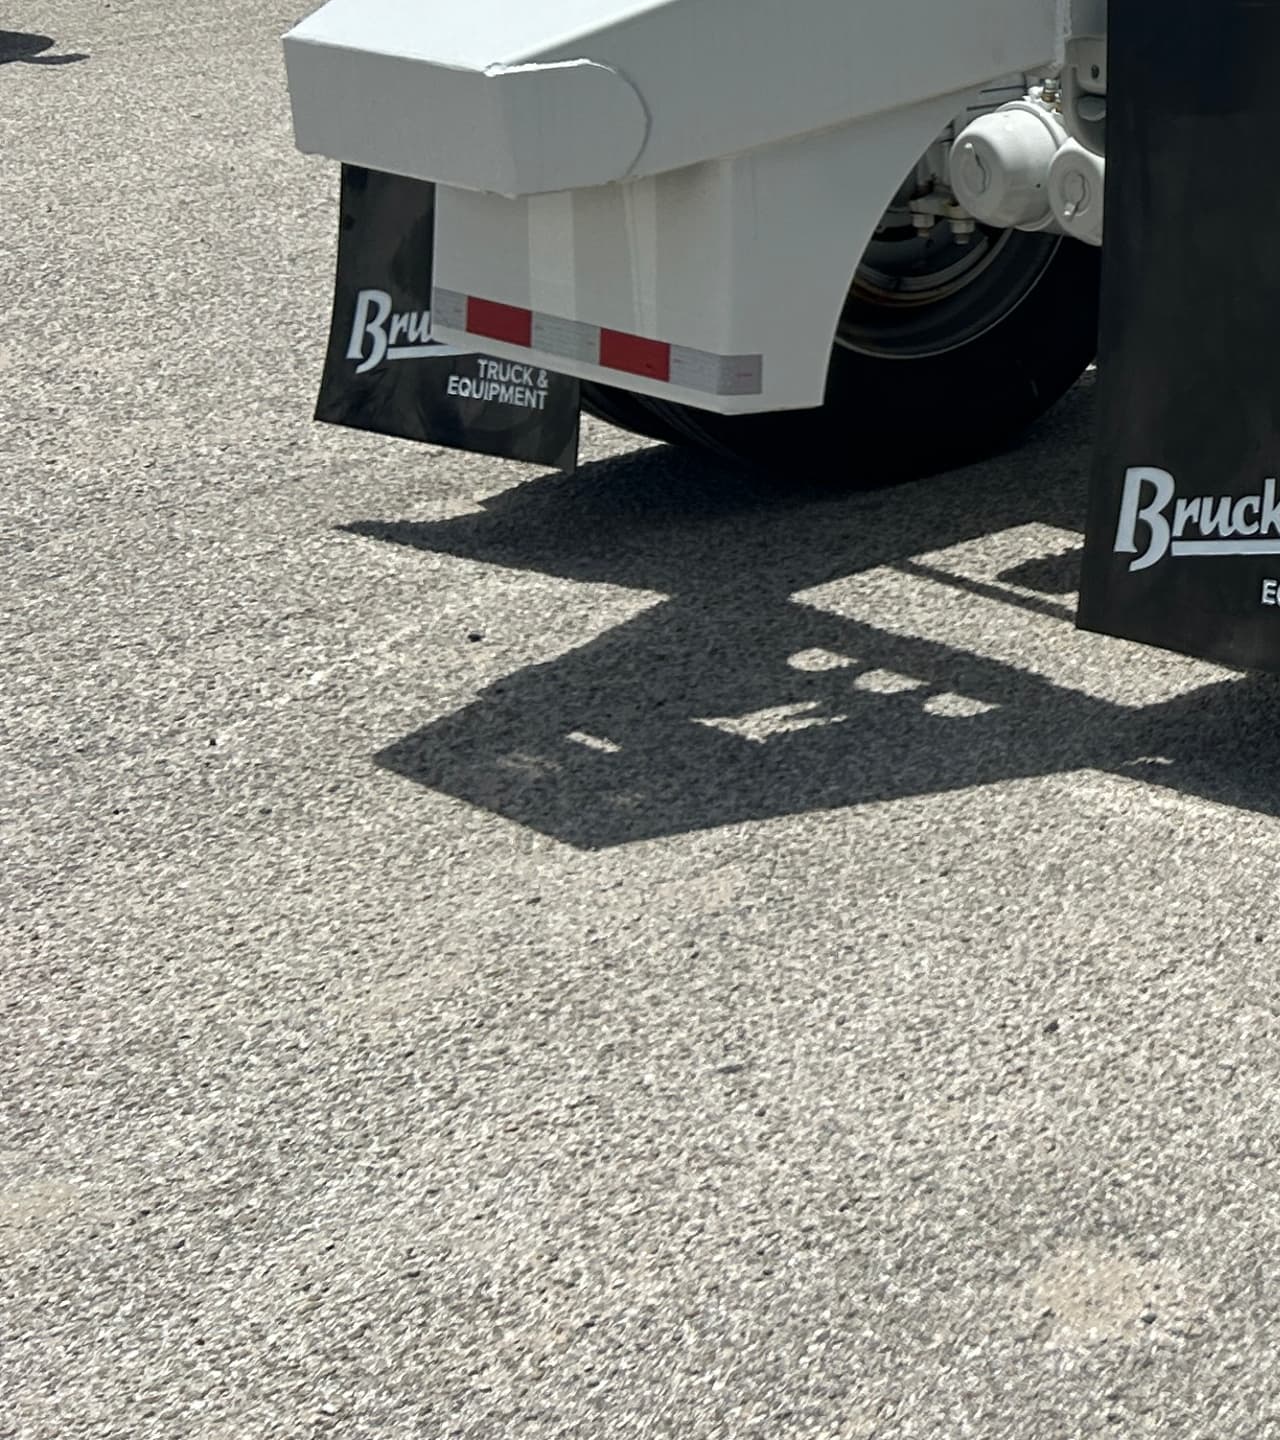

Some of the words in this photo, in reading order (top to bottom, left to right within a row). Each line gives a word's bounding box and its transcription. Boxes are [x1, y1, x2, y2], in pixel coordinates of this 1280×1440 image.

[477, 358, 533, 387] TRUCK
[536, 369, 549, 388] &
[447, 375, 549, 410] EQUIPMENT
